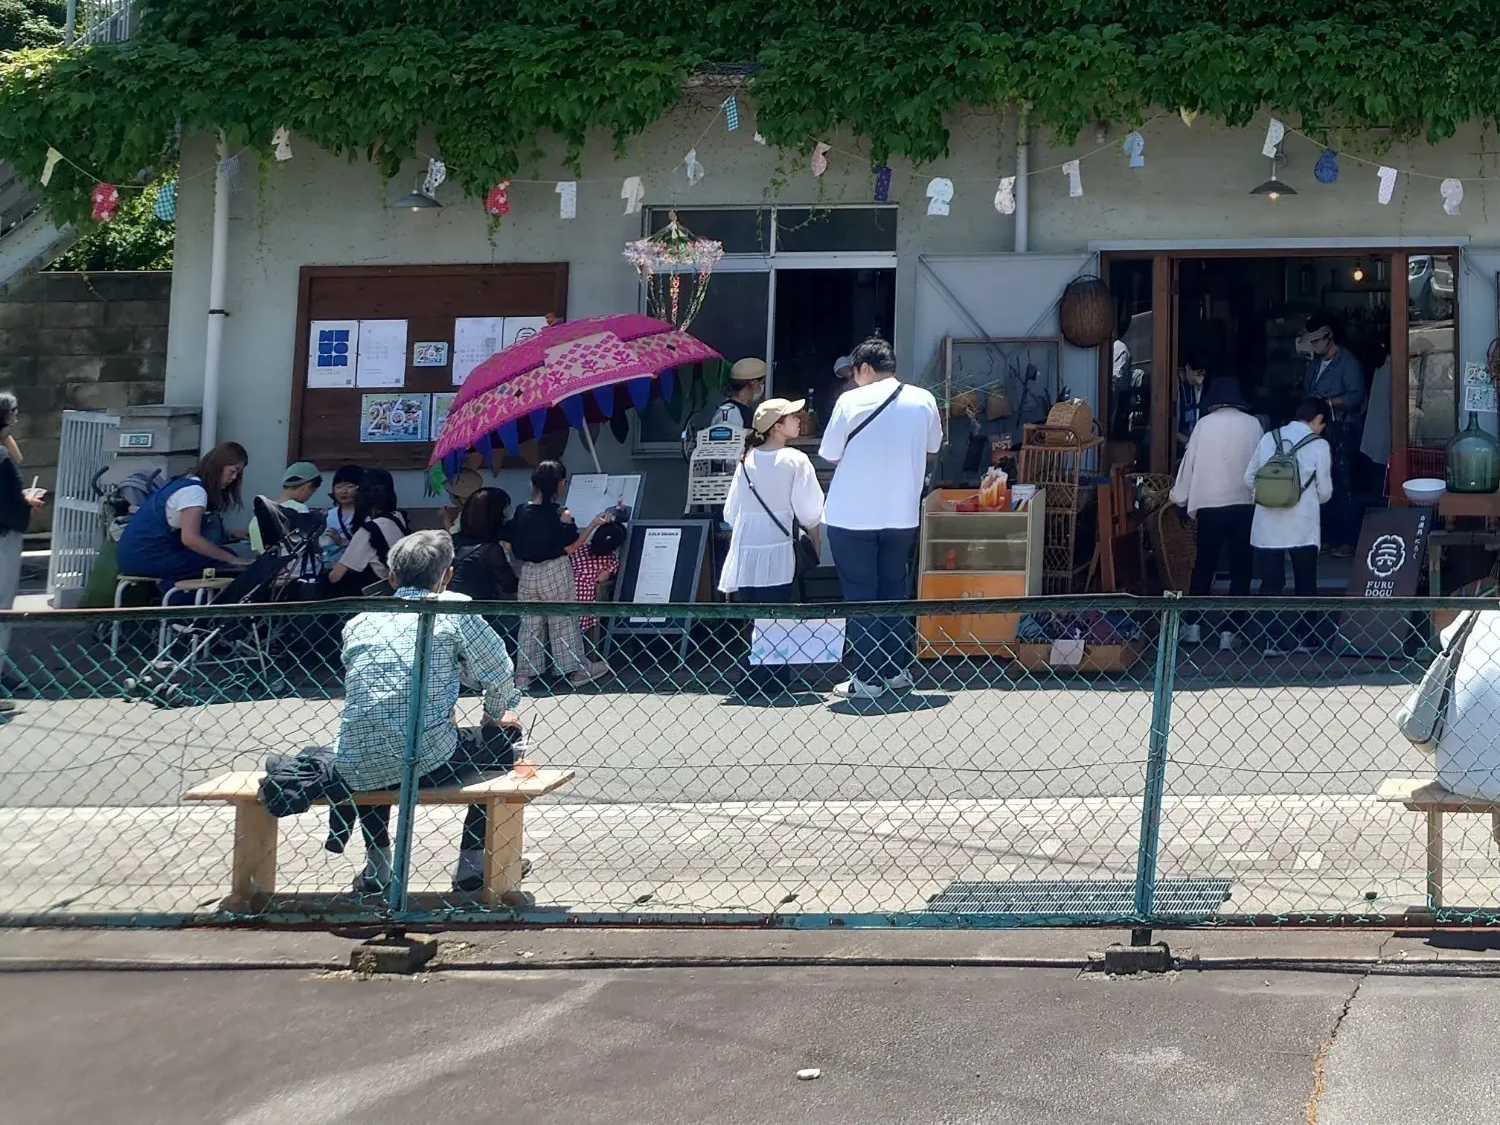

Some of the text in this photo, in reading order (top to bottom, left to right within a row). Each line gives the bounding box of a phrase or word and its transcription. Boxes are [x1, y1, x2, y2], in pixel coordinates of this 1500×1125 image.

[872, 164, 892, 202] 1
[926, 177, 954, 216] 2
[994, 169, 1016, 215] 6
[1062, 159, 1083, 197] 1
[1122, 131, 1145, 168] 2
[1377, 165, 1398, 205] 1
[555, 181, 577, 219] 1
[367, 398, 422, 439] 261
[1365, 588, 1392, 597] DOGU
[1366, 580, 1394, 589] FURU
